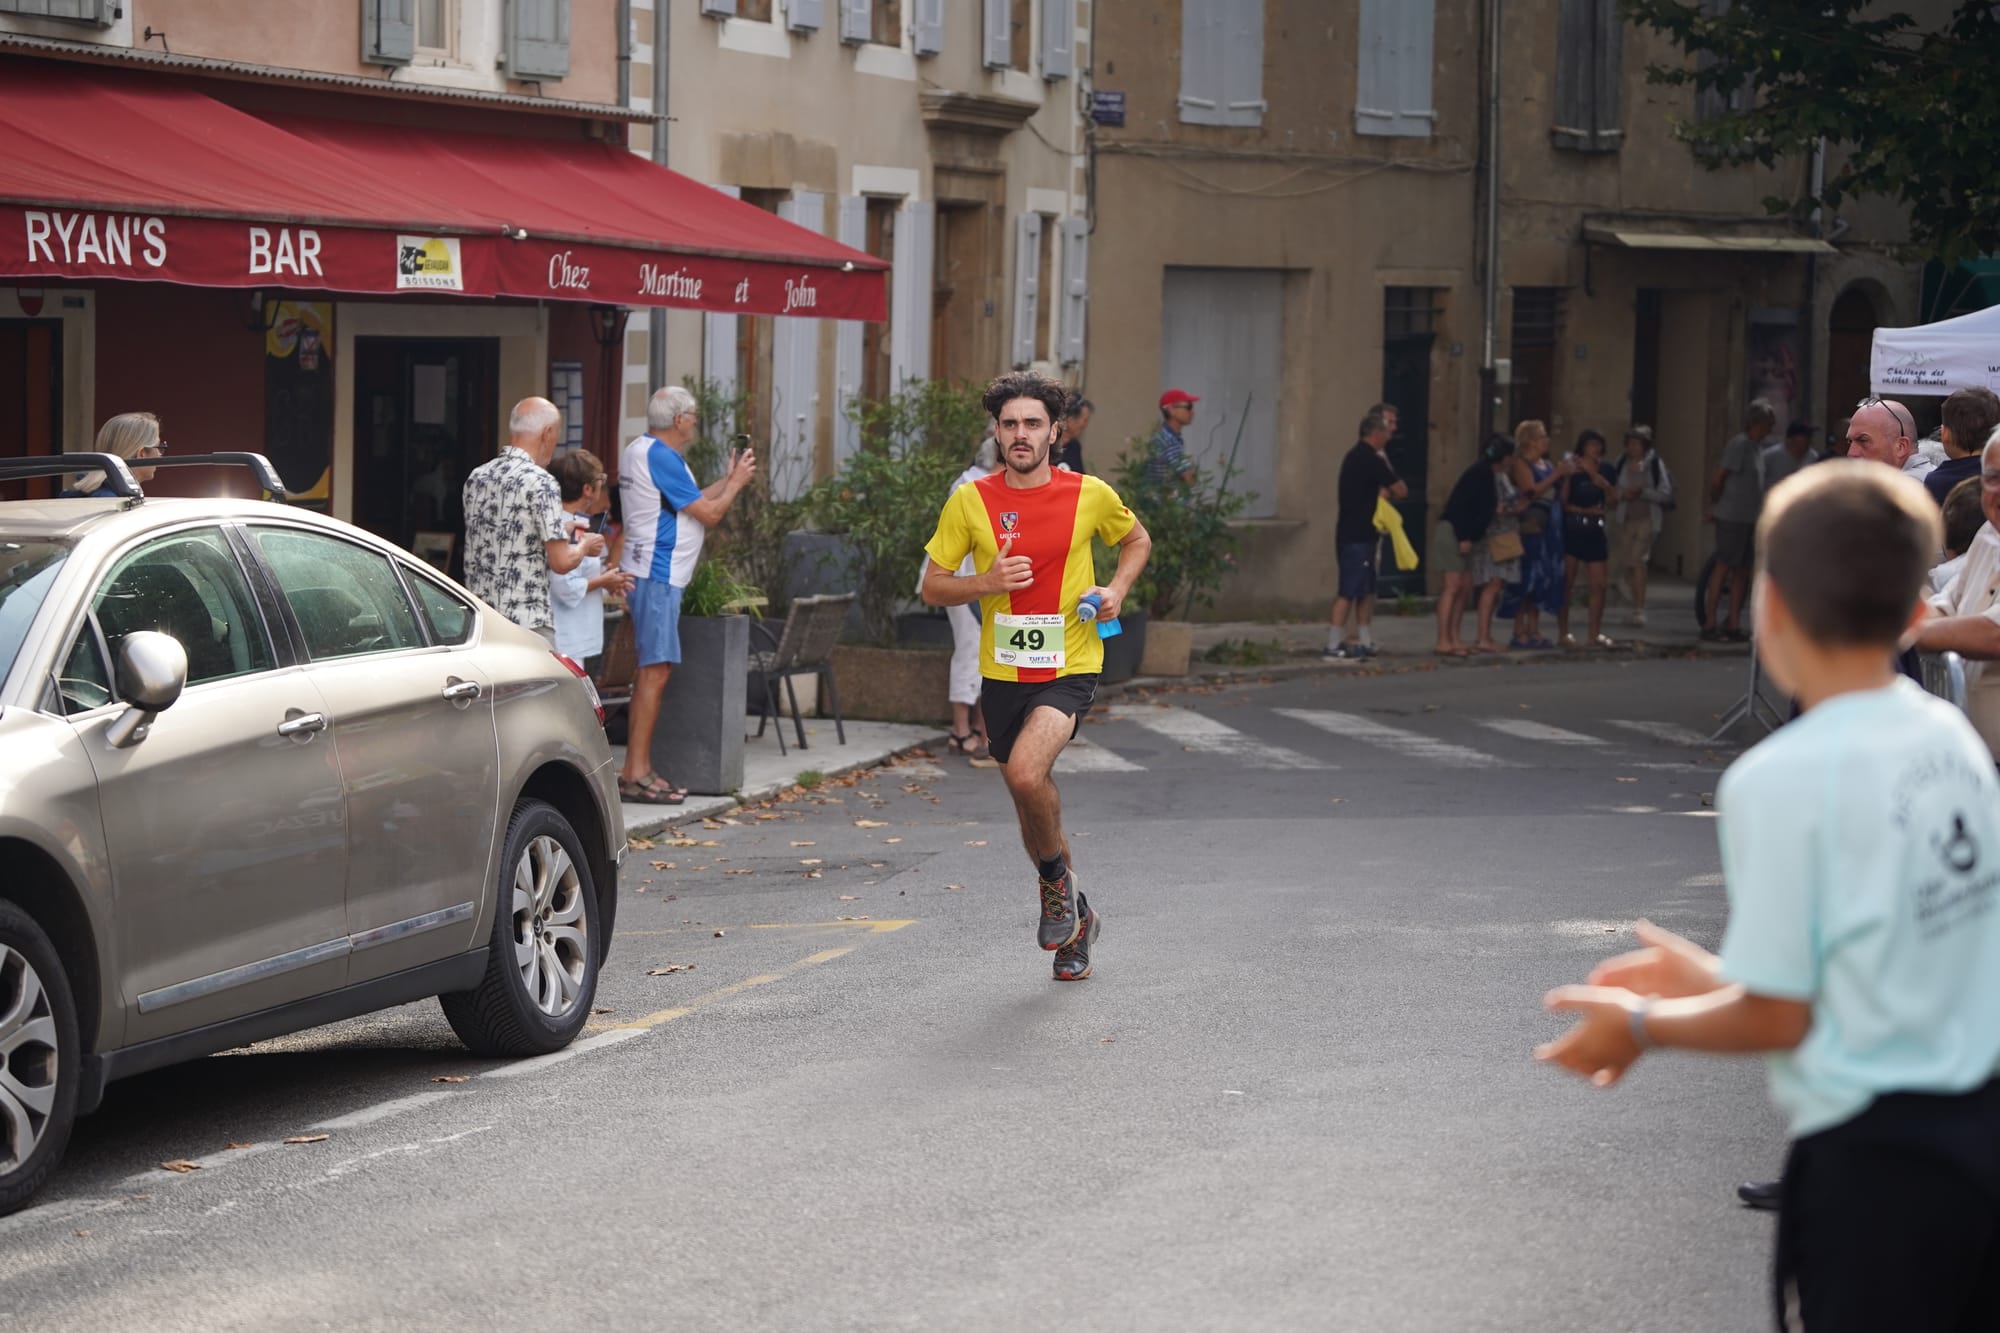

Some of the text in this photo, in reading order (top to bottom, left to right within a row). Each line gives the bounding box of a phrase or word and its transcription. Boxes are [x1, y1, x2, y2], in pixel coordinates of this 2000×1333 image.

[25, 210, 324, 276] RYAN'S BAR
[404, 276, 456, 287] BOISSONS
[548, 251, 817, 313] Chez Martine et John
[1009, 629, 1045, 651] 49
